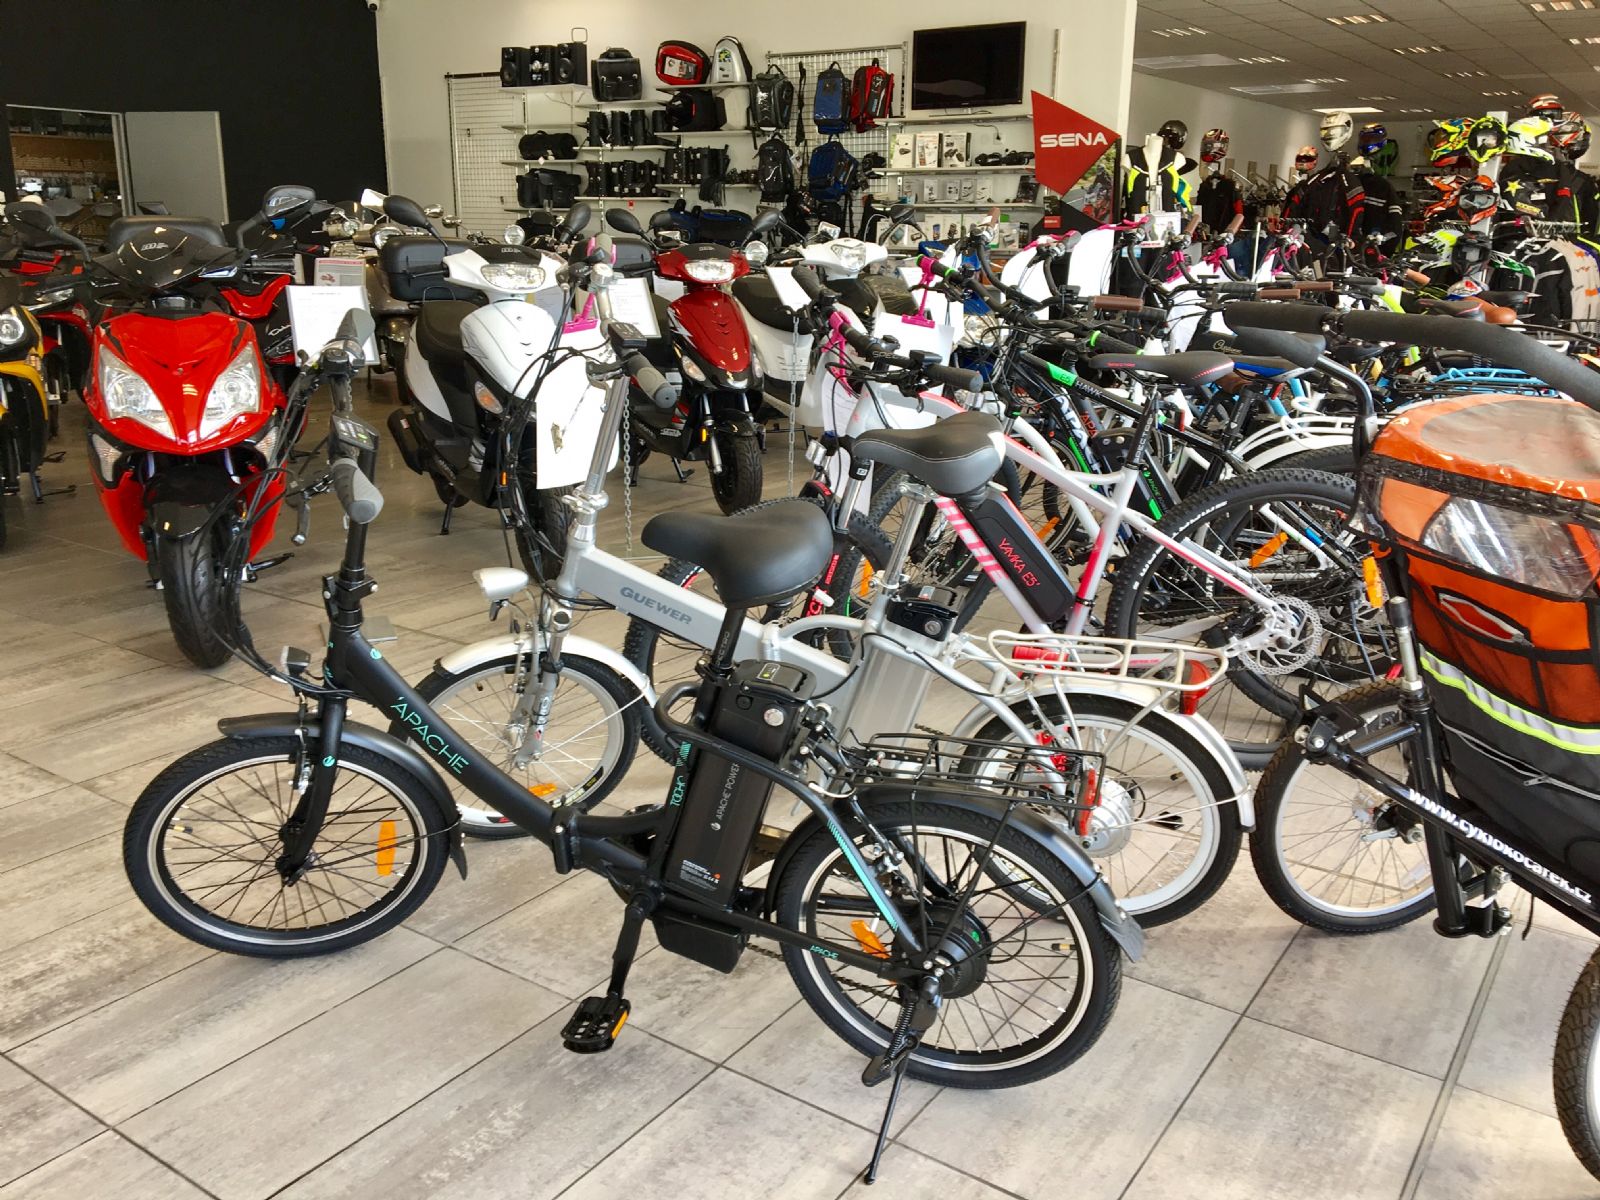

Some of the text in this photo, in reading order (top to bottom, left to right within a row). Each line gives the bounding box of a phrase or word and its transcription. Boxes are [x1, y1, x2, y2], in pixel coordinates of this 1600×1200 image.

[1040, 132, 1108, 148] SENA
[1075, 381, 1103, 398] HAWK
[620, 586, 693, 624] GUEWER
[715, 788, 732, 820] APACHE
[809, 944, 839, 960] APACHE
